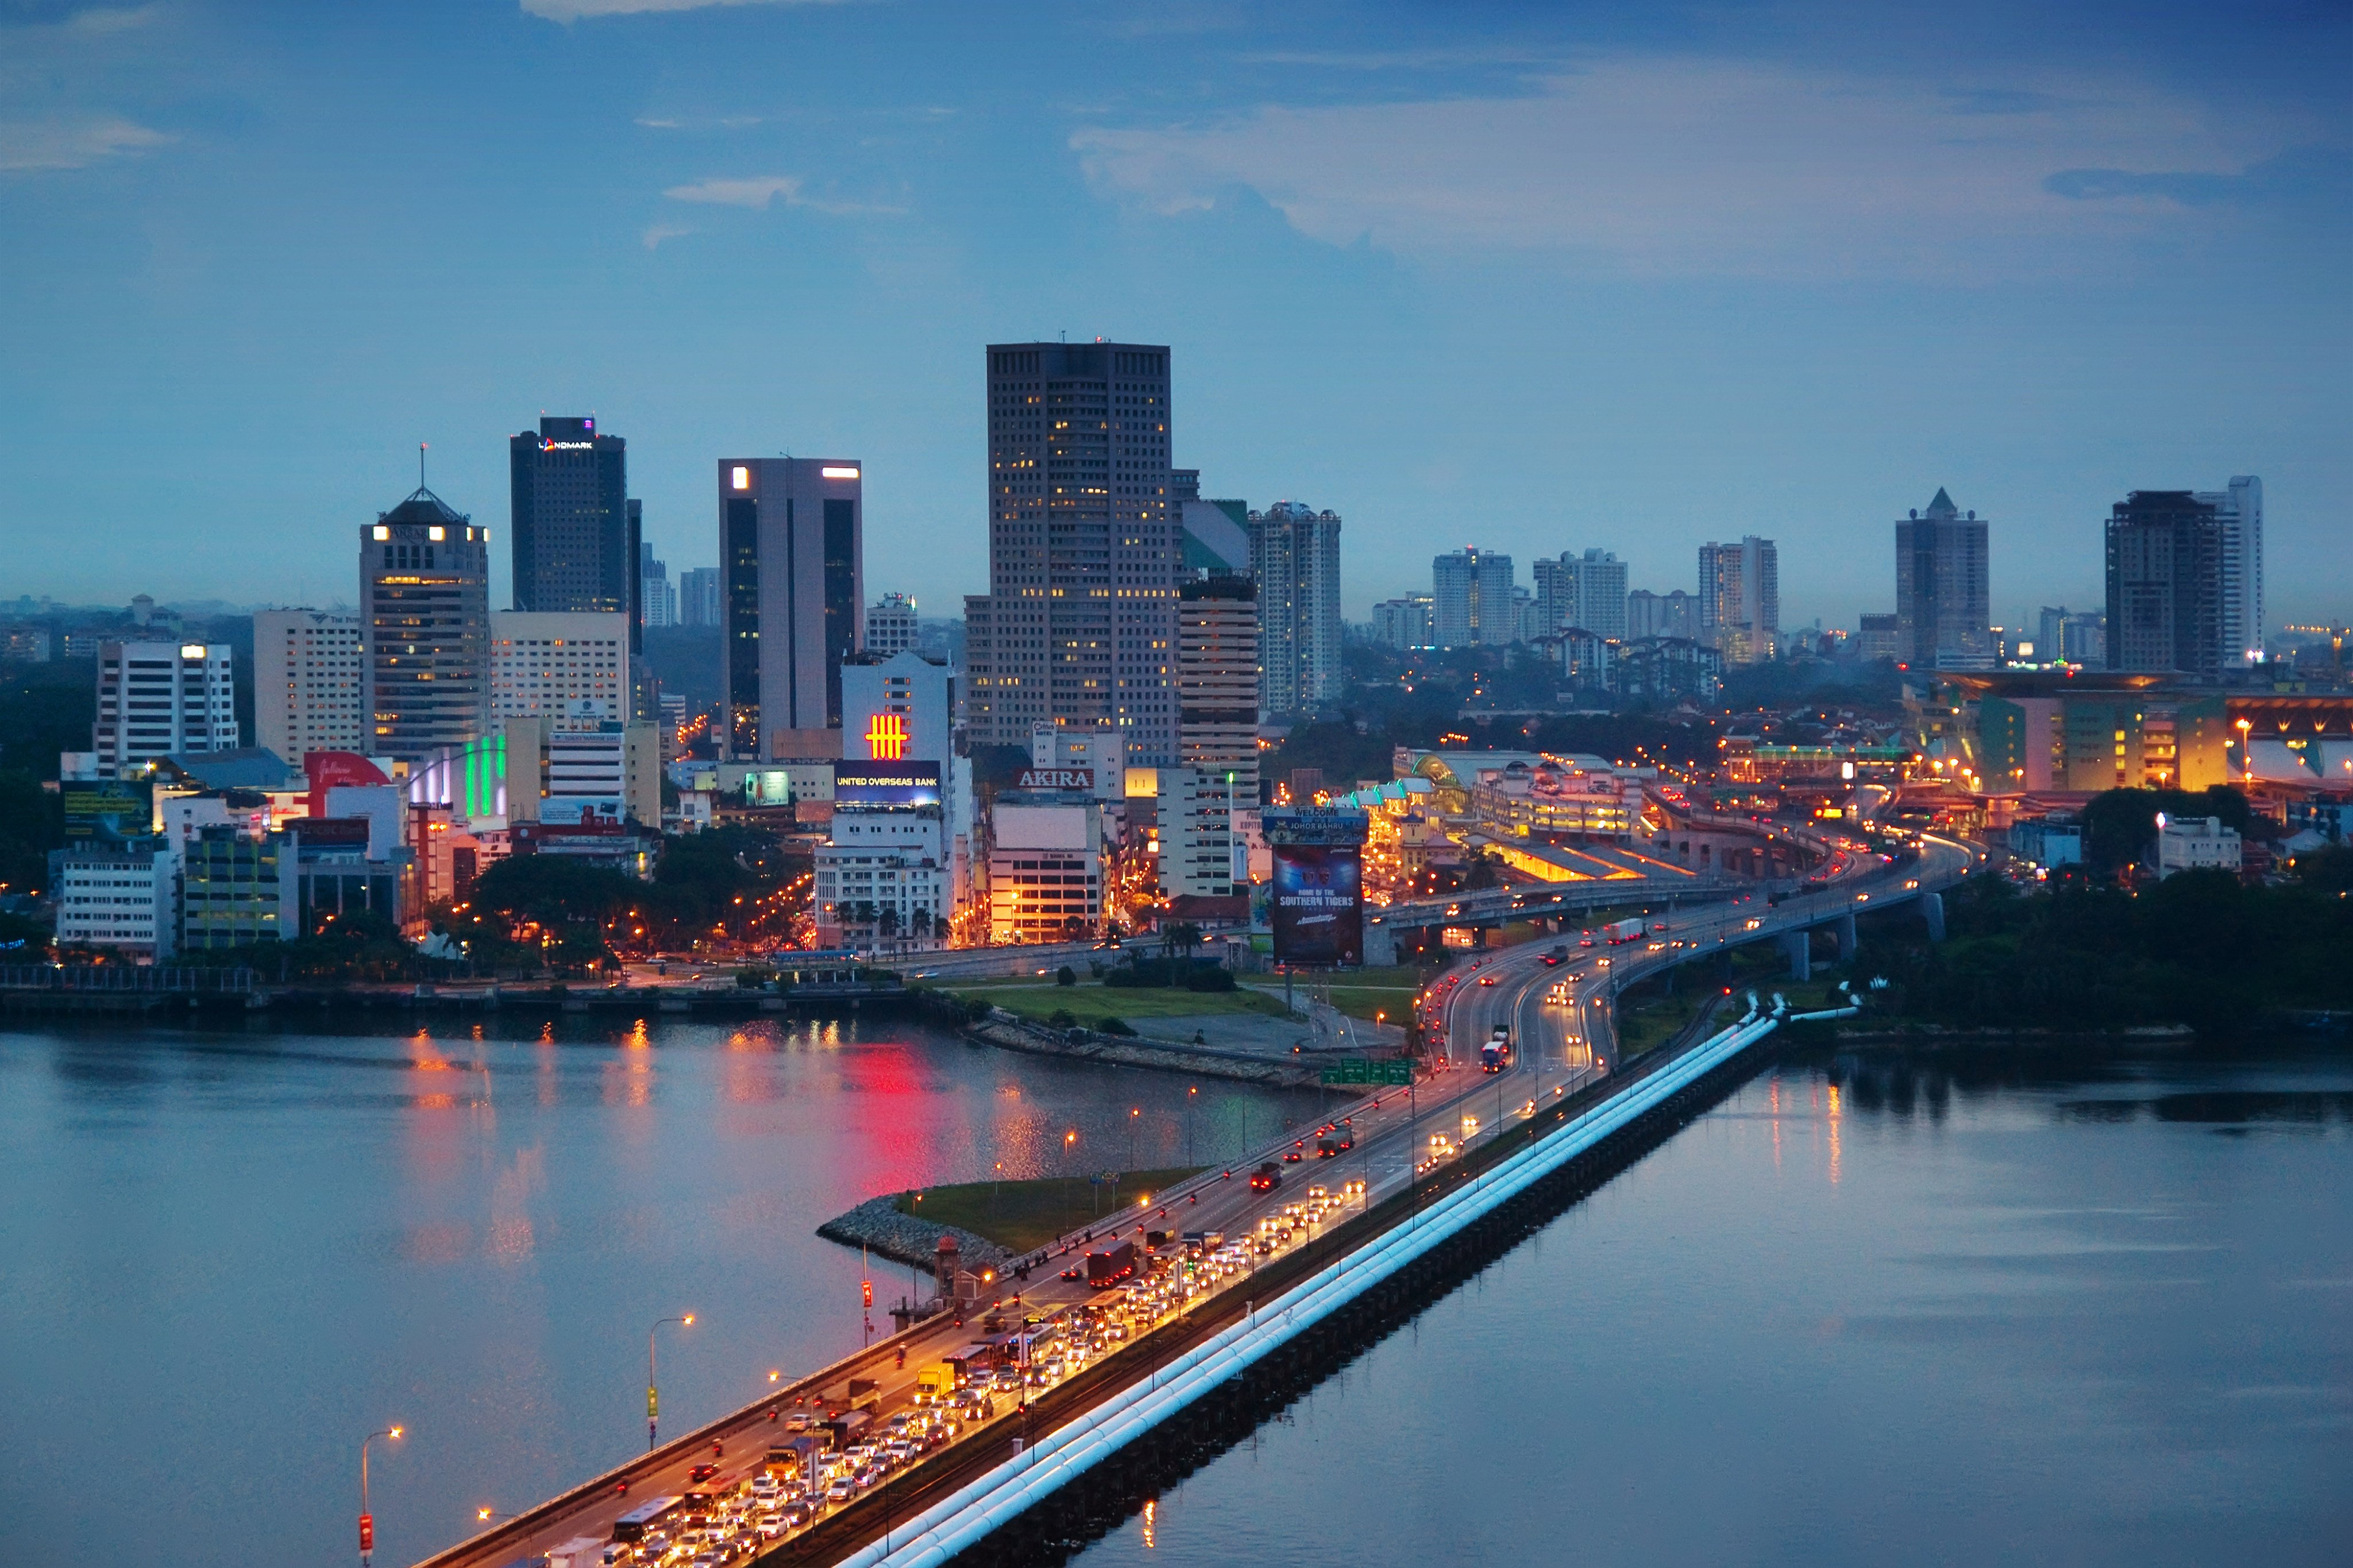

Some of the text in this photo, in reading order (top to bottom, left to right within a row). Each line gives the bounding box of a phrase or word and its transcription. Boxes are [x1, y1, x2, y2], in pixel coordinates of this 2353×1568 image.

[539, 438, 592, 451] LANDMARK
[837, 777, 867, 785] UNITED
[868, 778, 913, 786] OVERSEAS
[1019, 771, 1089, 786] AKIRA
[1280, 896, 1354, 906] SOUTHERN TIGERS
